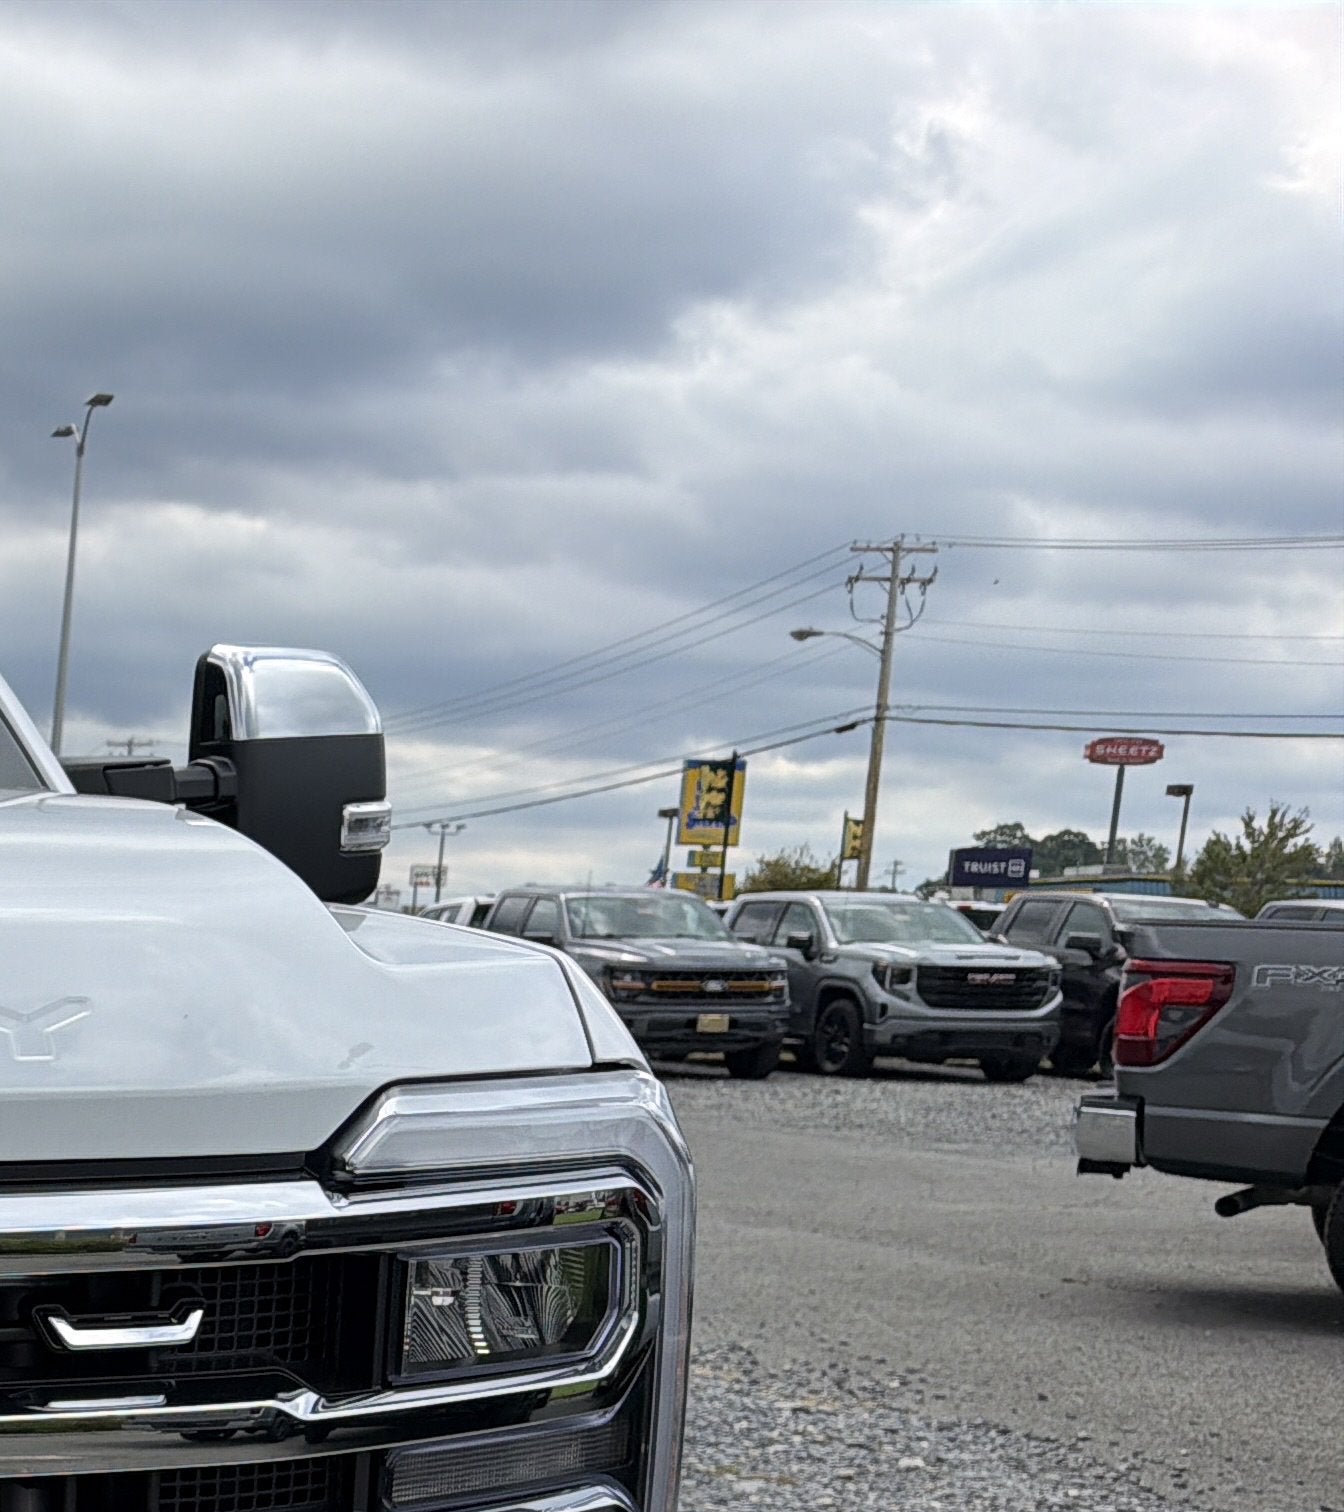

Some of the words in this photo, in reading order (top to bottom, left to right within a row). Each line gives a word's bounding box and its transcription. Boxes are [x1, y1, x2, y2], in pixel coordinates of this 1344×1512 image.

[1096, 744, 1159, 757] SHEETZ
[963, 860, 1007, 875] TRUIST
[1253, 964, 1344, 987] FX
